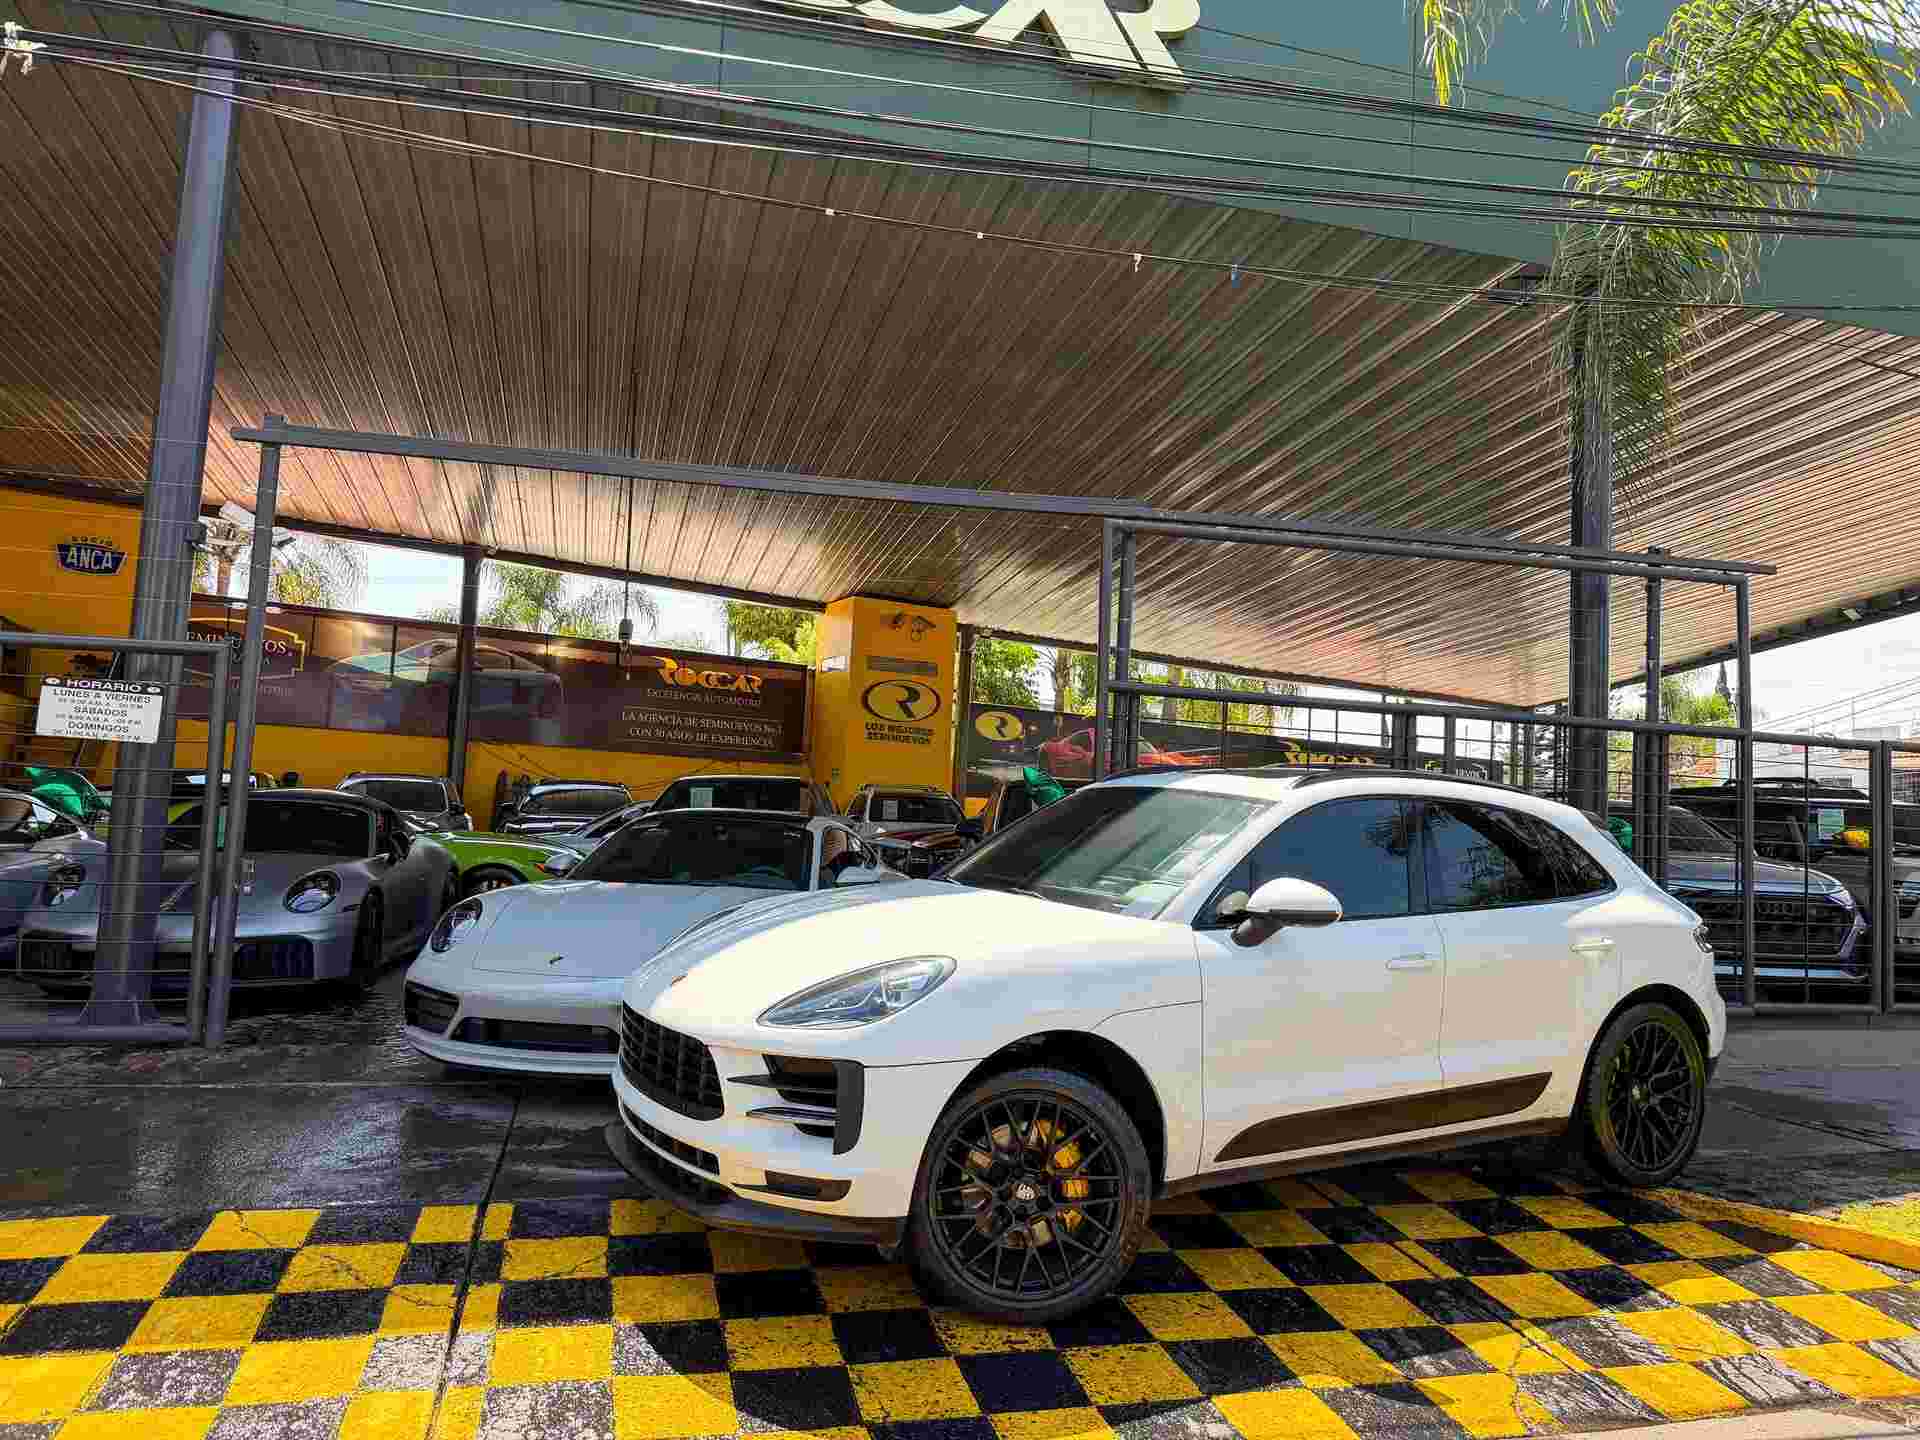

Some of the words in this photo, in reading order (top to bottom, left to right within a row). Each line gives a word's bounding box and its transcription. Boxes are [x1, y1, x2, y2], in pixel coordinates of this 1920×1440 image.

[65, 545, 113, 570] ANCA
[65, 678, 142, 694] HORARIO
[52, 688, 90, 699] LUNES
[104, 692, 152, 704] VIERNES
[67, 720, 130, 733] DOMINGOS
